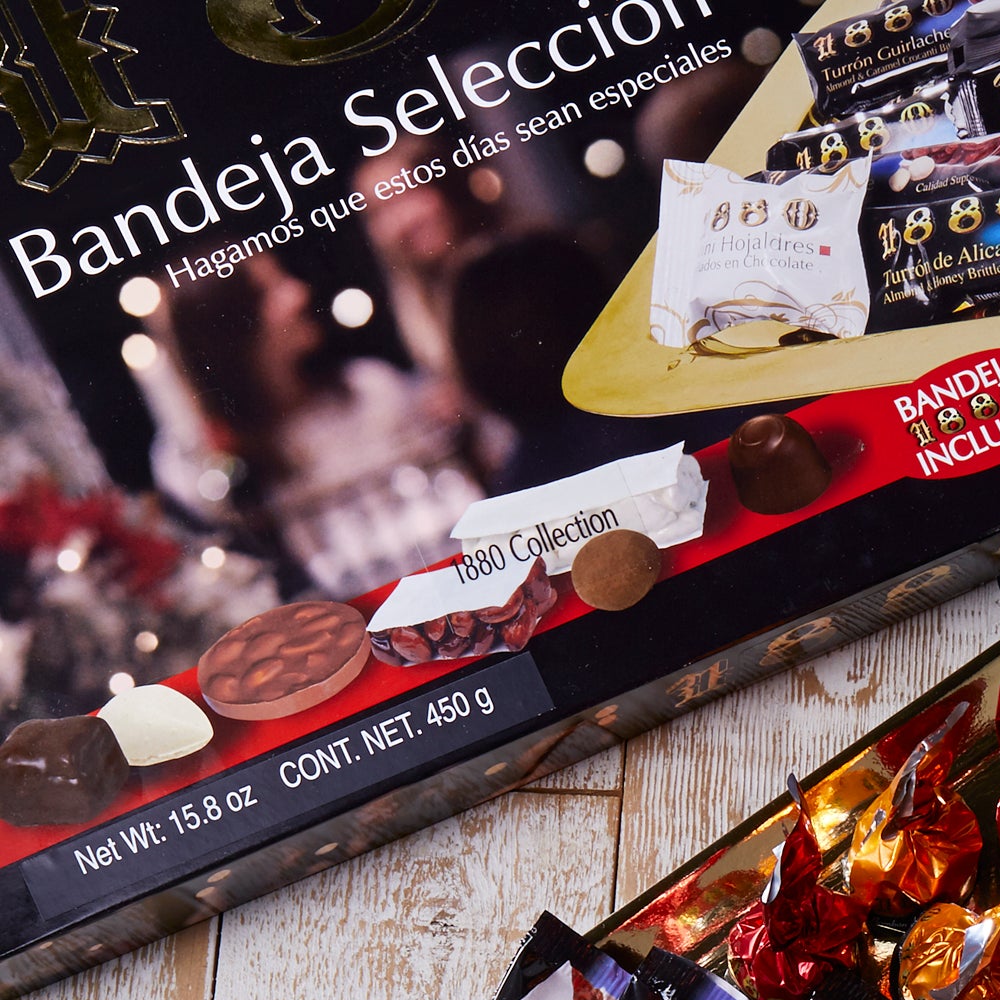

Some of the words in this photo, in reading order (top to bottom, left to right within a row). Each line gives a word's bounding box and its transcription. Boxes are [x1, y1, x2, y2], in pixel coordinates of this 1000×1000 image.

[821, 55, 873, 81] Turrón
[877, 28, 951, 61] Guirlache
[165, 217, 304, 288] Hagamos
[310, 190, 367, 232] que
[374, 157, 446, 200] estos
[452, 129, 510, 169] días
[515, 101, 582, 142] sean
[588, 37, 732, 110] especiales
[796, 102, 936, 173] 1880
[915, 179, 949, 193] Calidad
[8, 133, 336, 299] Bandeja
[721, 232, 815, 256] Hojaldres
[724, 258, 740, 270] en
[883, 258, 932, 289] Turrón
[933, 252, 953, 271] de
[933, 271, 964, 291] Honey
[450, 544, 505, 584] 1880
[509, 508, 619, 562] Collection
[73, 839, 122, 875] Net
[119, 820, 167, 855] Wt:
[168, 795, 223, 836] 15.8
[225, 784, 258, 813] oz
[279, 737, 360, 790] CONT.
[361, 711, 423, 757] NET.
[426, 690, 471, 728] 450
[475, 685, 495, 715] g
